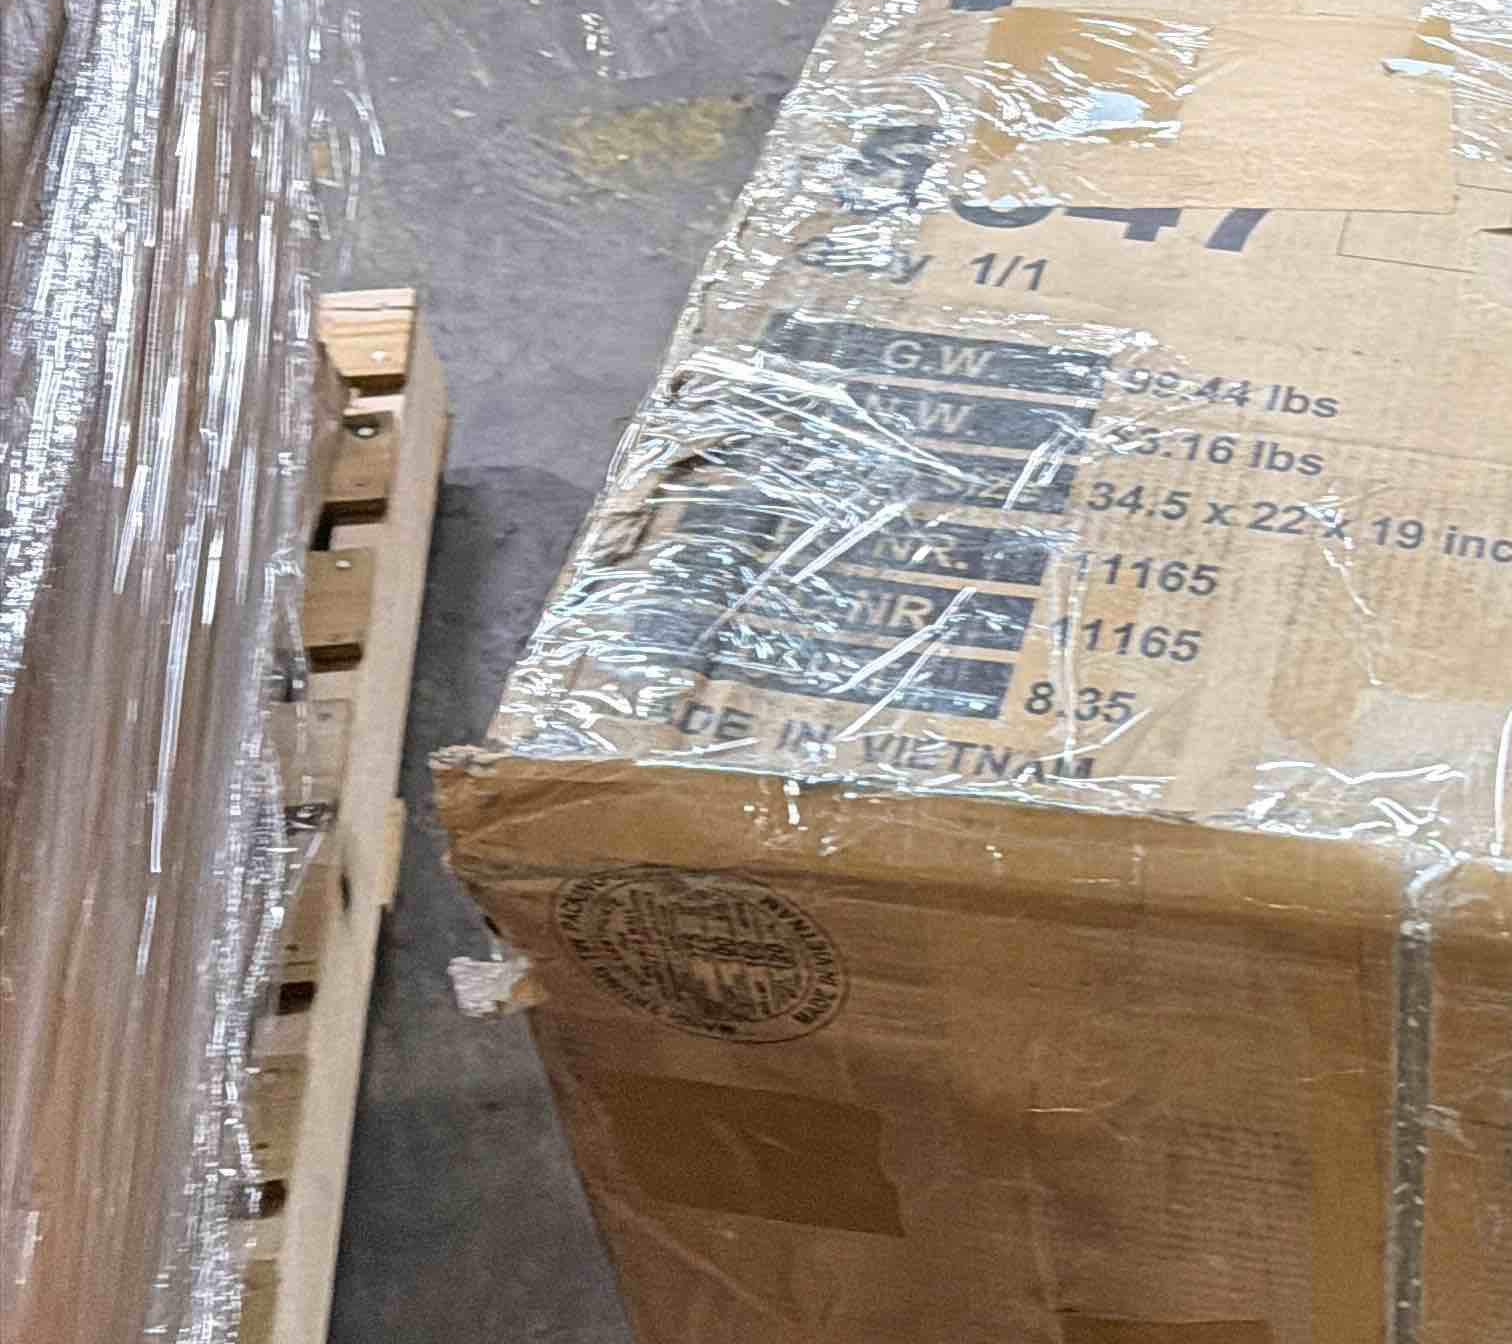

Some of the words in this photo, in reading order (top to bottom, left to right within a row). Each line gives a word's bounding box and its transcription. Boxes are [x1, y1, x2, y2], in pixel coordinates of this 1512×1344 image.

[968, 250, 1049, 293] 1/1
[1264, 383, 1340, 419] lbs
[1250, 439, 1326, 478] lbs
[1086, 480, 1193, 522] 34.5
[1202, 500, 1236, 528] x
[1246, 500, 1307, 536] 22
[1371, 516, 1426, 550] 19
[1052, 614, 1204, 663] 11165
